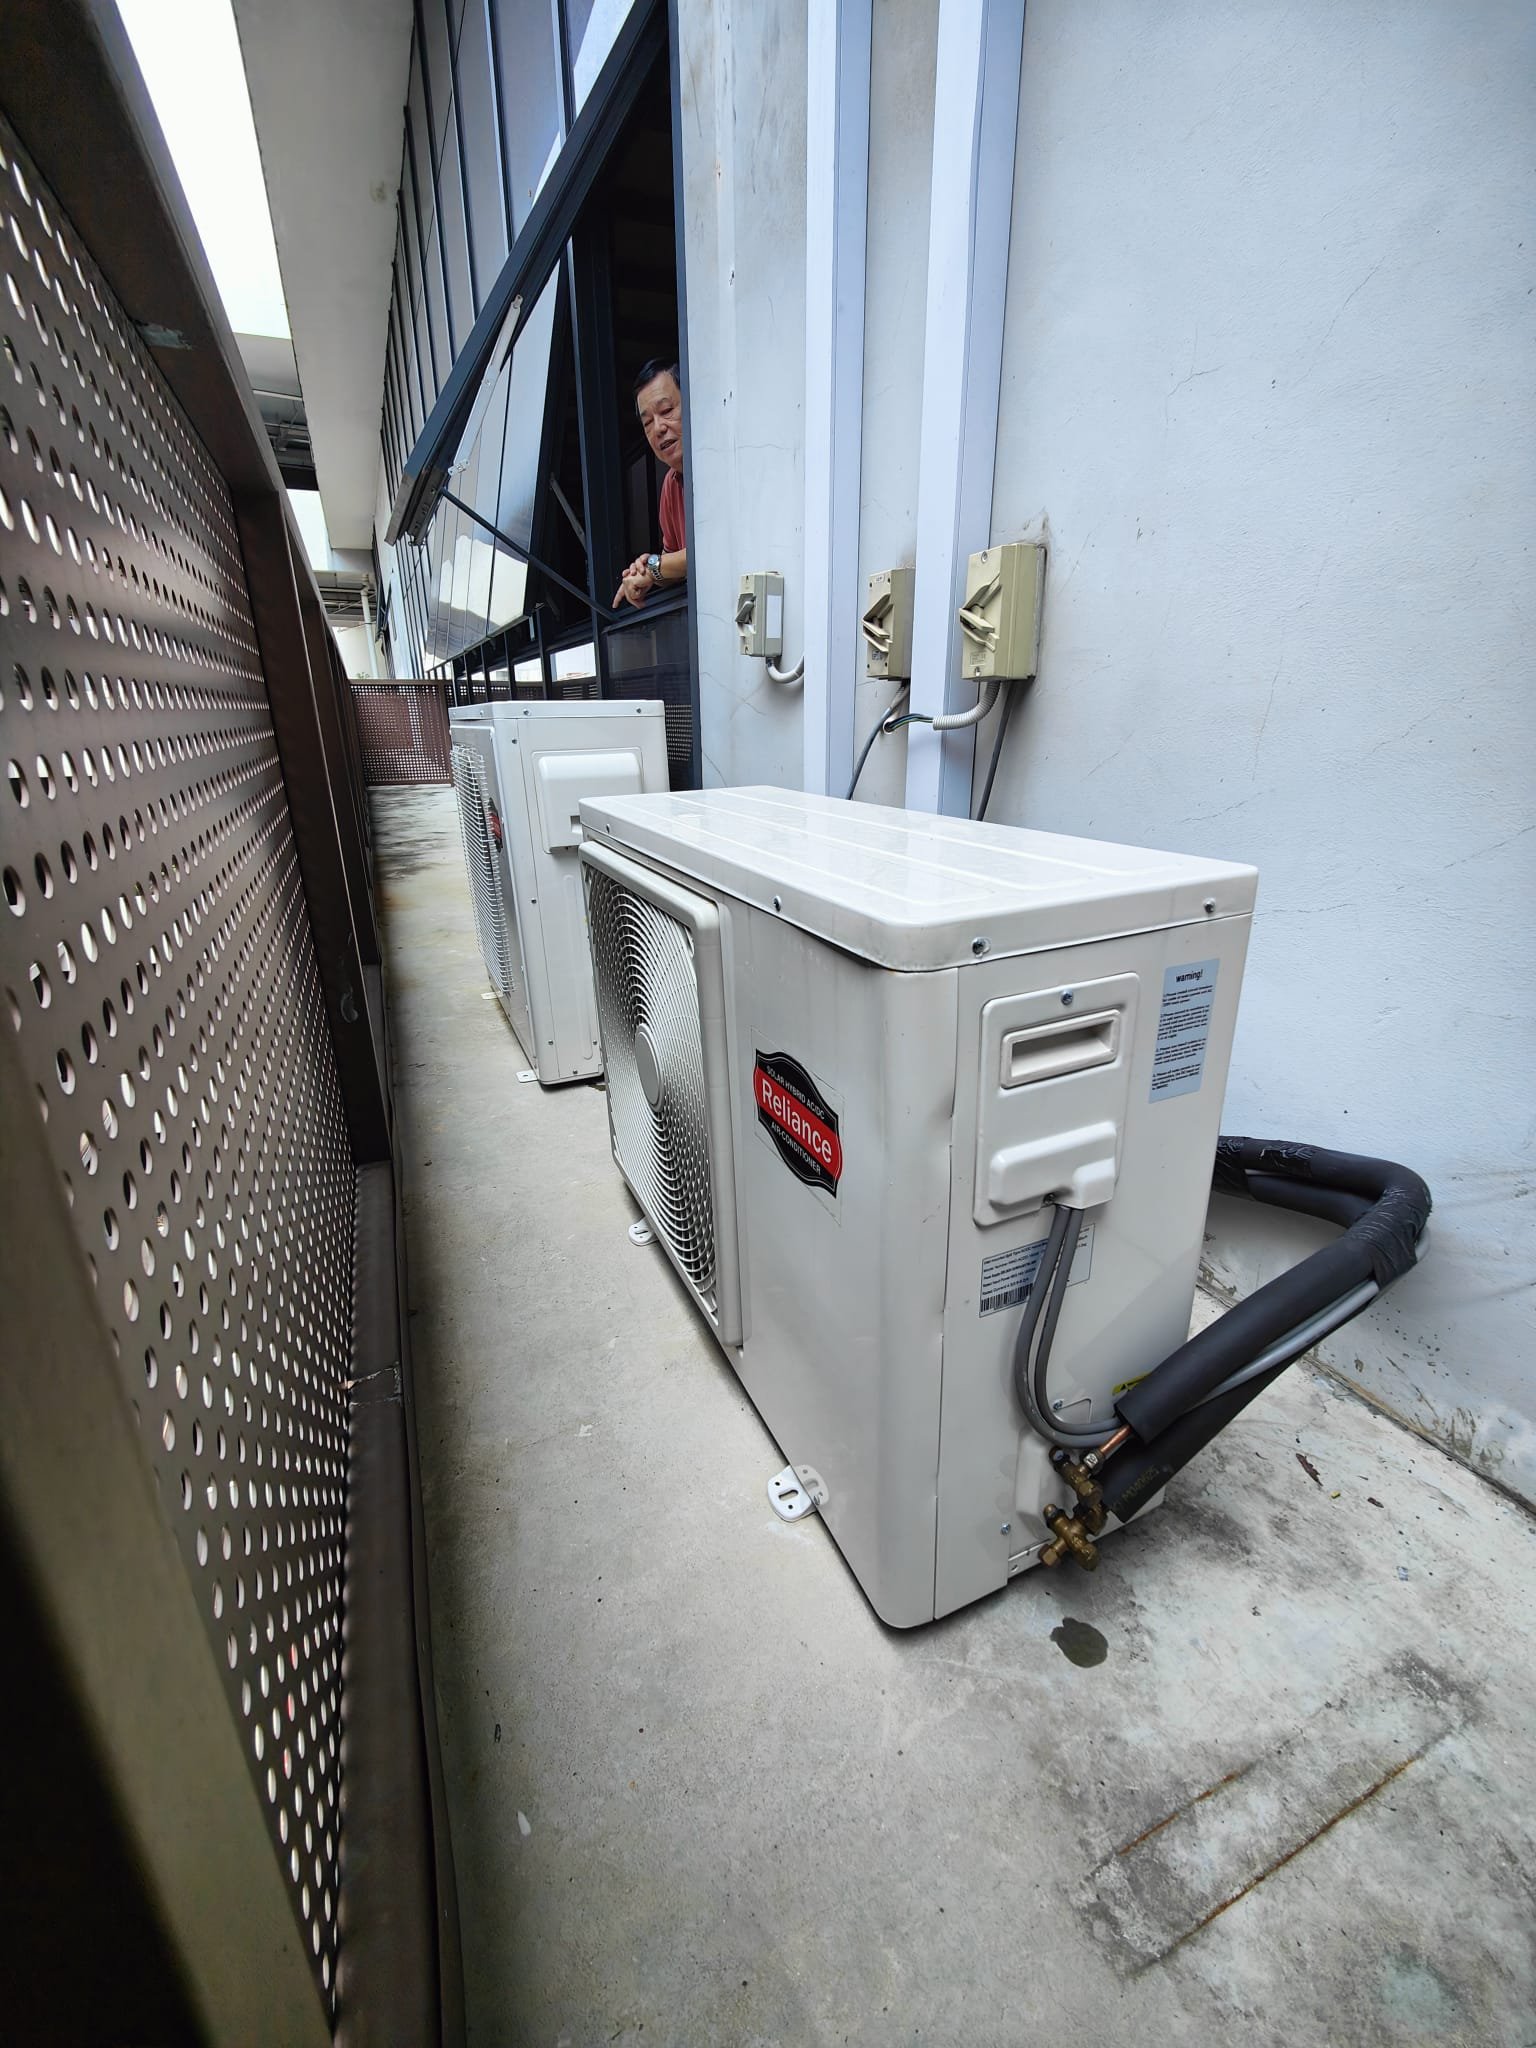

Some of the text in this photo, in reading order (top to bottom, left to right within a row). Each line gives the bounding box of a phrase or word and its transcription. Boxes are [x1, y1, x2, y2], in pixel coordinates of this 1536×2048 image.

[1175, 969, 1204, 983] warning!
[766, 1065, 785, 1087] SOLAR
[785, 1081, 806, 1104] HYBRID
[761, 1078, 832, 1164] Reliance
[770, 1121, 821, 1176] AIR-CONDITIONER
